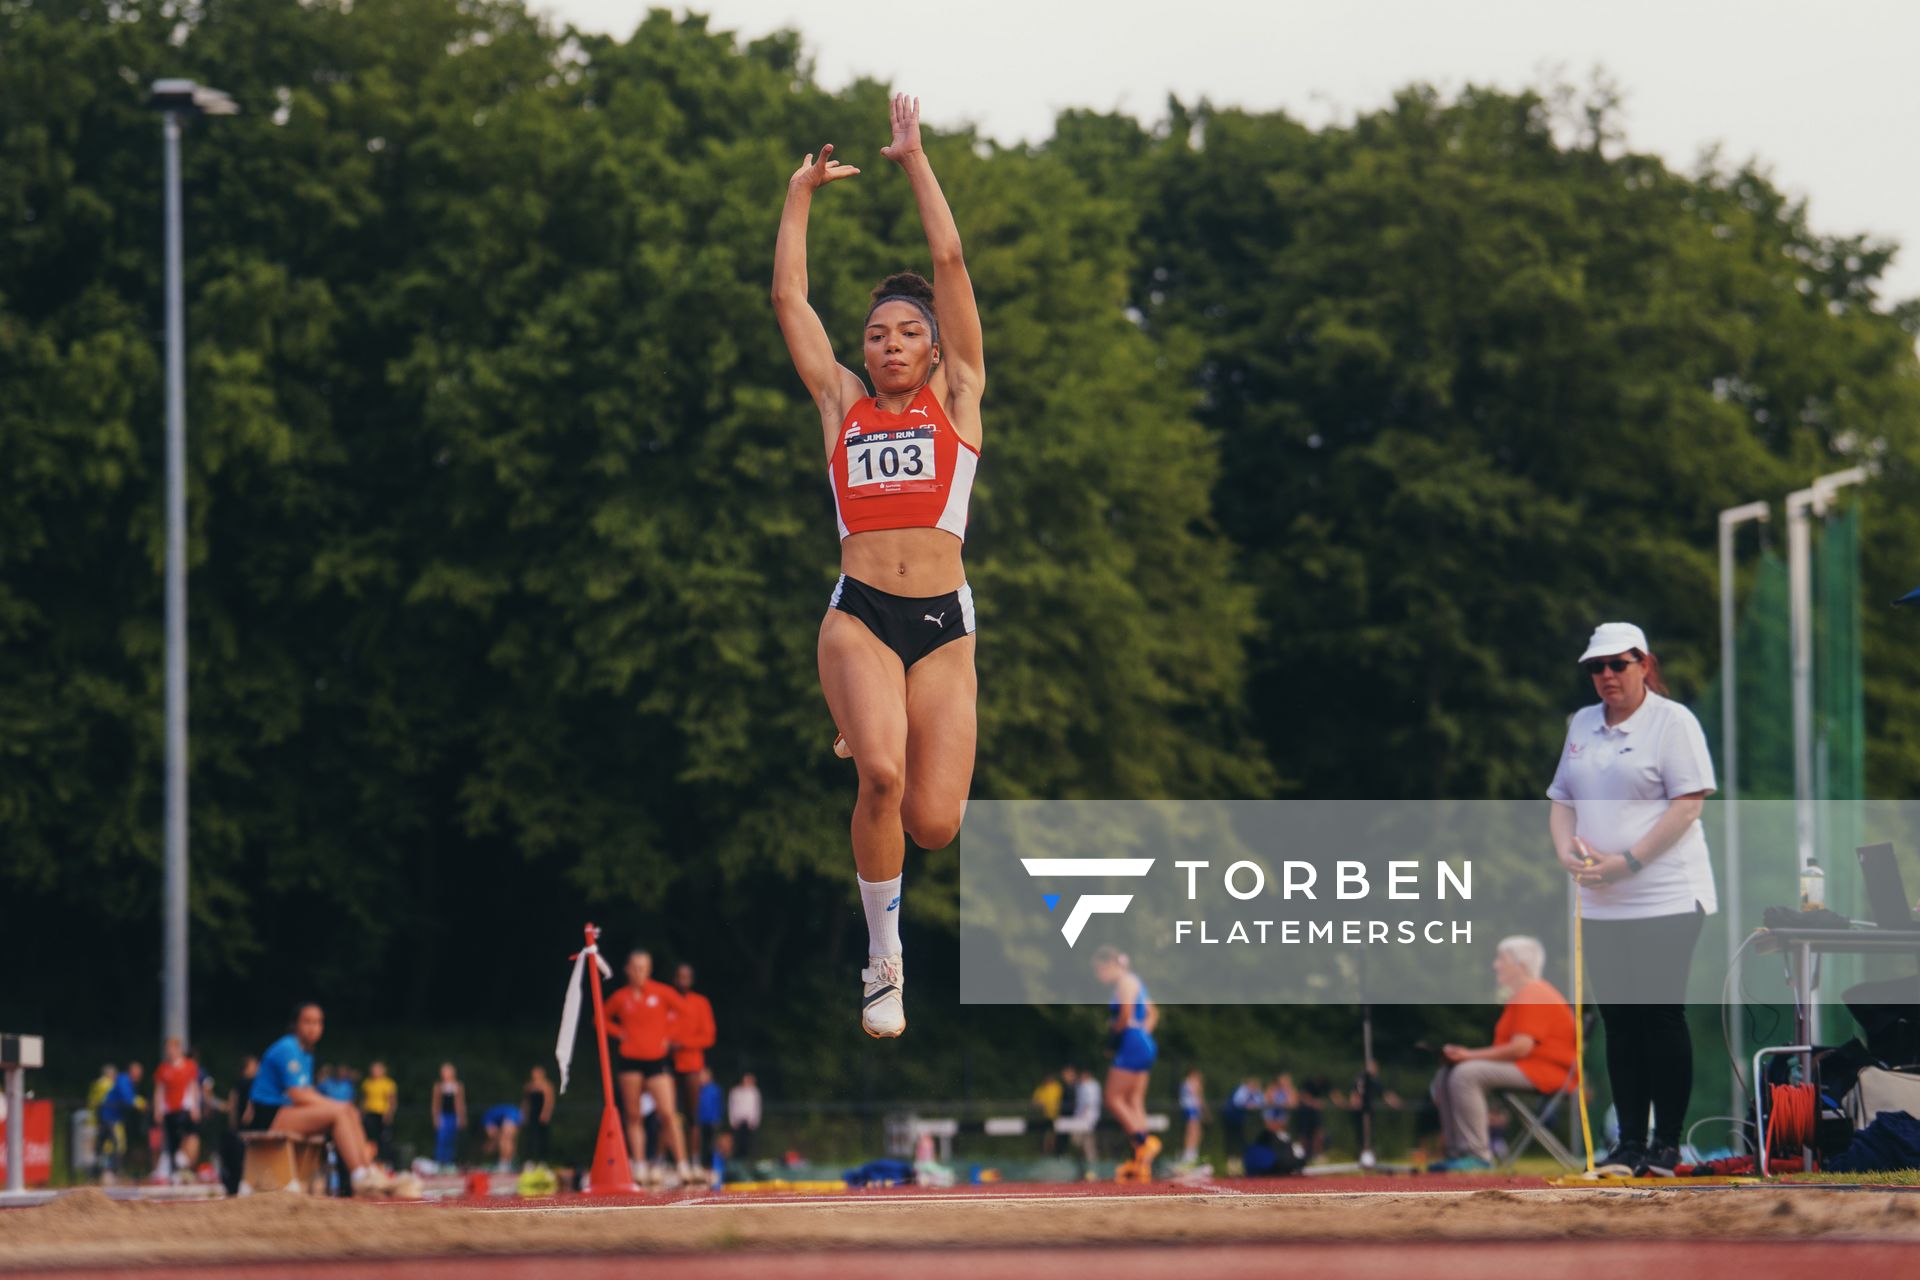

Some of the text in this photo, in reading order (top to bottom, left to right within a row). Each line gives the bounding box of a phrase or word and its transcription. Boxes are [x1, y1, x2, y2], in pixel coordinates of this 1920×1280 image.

[864, 433, 888, 442] JUMP
[896, 430, 915, 439] RUN
[857, 444, 924, 480] 103
